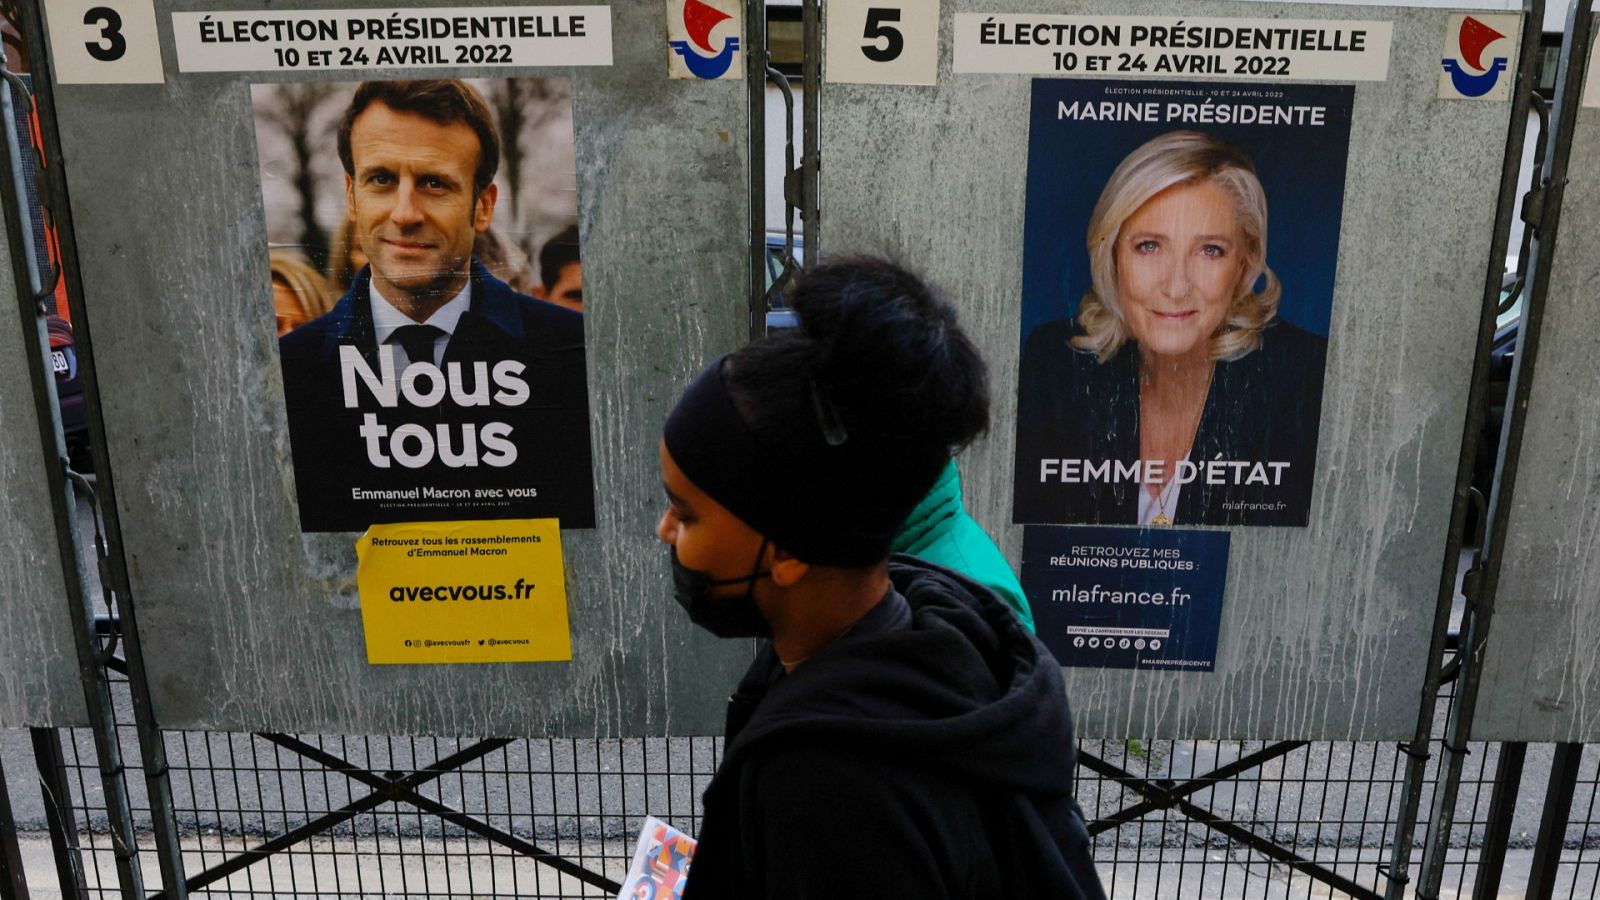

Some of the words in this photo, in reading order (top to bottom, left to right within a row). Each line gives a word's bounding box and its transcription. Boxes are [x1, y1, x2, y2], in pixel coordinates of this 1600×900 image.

[84, 7, 126, 61] 3
[199, 15, 338, 42] ÉLECTION
[347, 13, 585, 40] PRÉSIDENTIELLE
[861, 8, 903, 62] 5
[981, 17, 1120, 46] ÉLECTION
[1130, 20, 1366, 52] PRÉSIDENTIELLE
[274, 48, 299, 66] 10
[308, 51, 332, 66] ET
[339, 47, 369, 65] 24
[376, 46, 449, 65] AVRIL
[455, 45, 512, 63] 2022
[1053, 52, 1077, 70] 10
[1086, 56, 1111, 71] ET
[1118, 53, 1147, 71] 24
[1154, 54, 1227, 73] AVRIL
[1234, 56, 1290, 75] 2022
[1058, 101, 1159, 121] MARINE
[1167, 97, 1326, 125] PRÉSIDENTE
[339, 345, 530, 408] Nous
[360, 413, 517, 468] tous
[1040, 459, 1164, 484] FEMME
[352, 487, 419, 499] Emmanuel
[423, 487, 470, 498] Macron
[475, 489, 503, 497] avec
[507, 488, 537, 497] vous
[1222, 500, 1286, 511] mlafrance.fr
[372, 538, 419, 546] Retrouvez
[446, 536, 458, 546] les
[462, 535, 541, 544] rassemblements
[471, 547, 507, 555] Macron
[1072, 546, 1150, 558] RETROUVEZ
[1153, 549, 1180, 558] MES
[1050, 555, 1118, 567] RÉUNIONS
[1122, 559, 1194, 570] PUBLIQUES
[390, 578, 535, 602] avecvous.fr
[1053, 584, 1190, 605] mlafrance.fr
[424, 639, 470, 648] @avecvousfr
[488, 638, 530, 647] @avecvous
